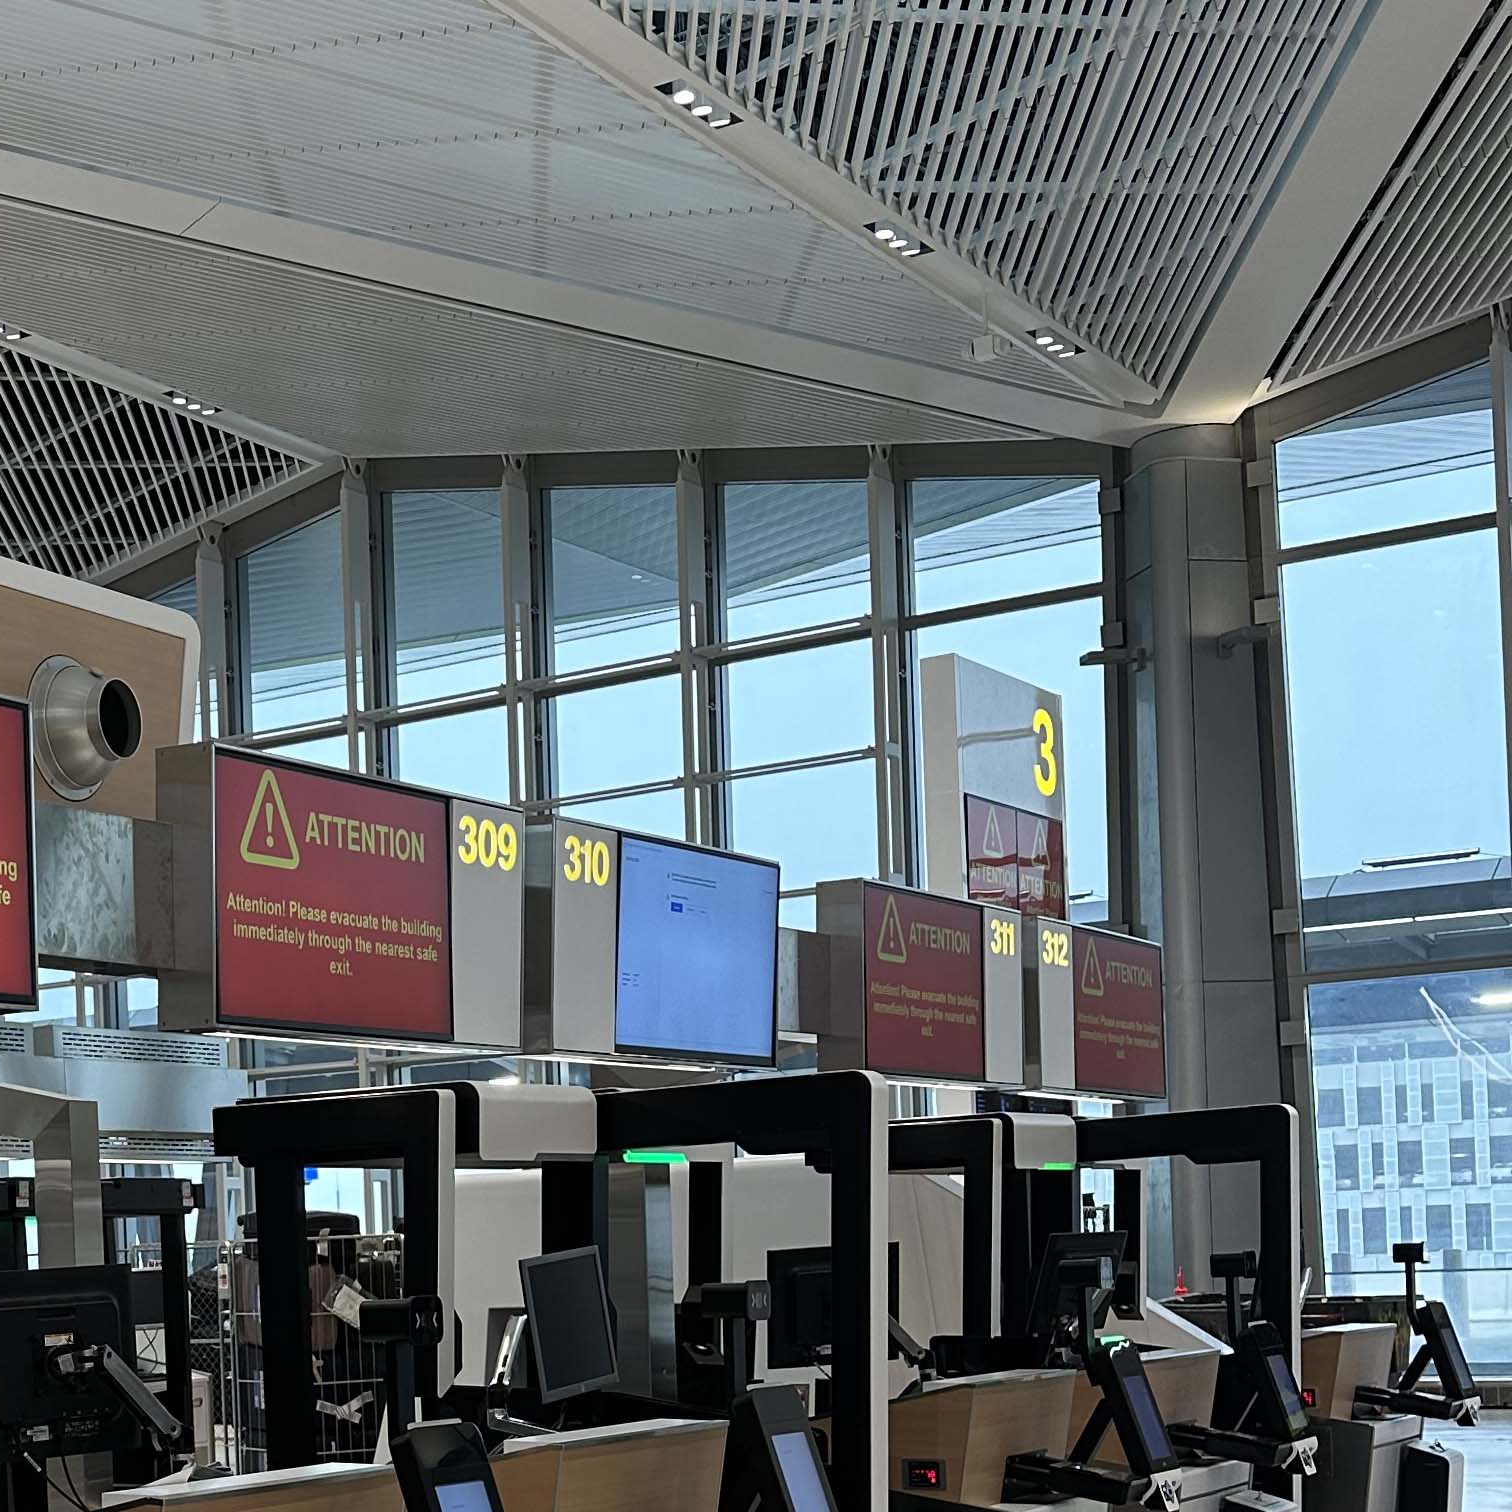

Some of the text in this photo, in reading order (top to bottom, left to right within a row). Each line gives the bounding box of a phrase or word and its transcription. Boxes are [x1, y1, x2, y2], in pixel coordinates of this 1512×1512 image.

[1031, 706, 1058, 798] 3
[304, 810, 426, 864] ATTENTION
[457, 814, 518, 871] 309
[563, 834, 610, 887] 310
[226, 891, 442, 943] Attention! Please evacuate the building
[910, 921, 970, 955] ATTENTION
[990, 918, 1016, 957] 311
[233, 918, 438, 962] immediately through the nearest safe
[1041, 929, 1070, 968] 312
[329, 959, 353, 976] exit.
[1105, 959, 1153, 989] ATTENTION
